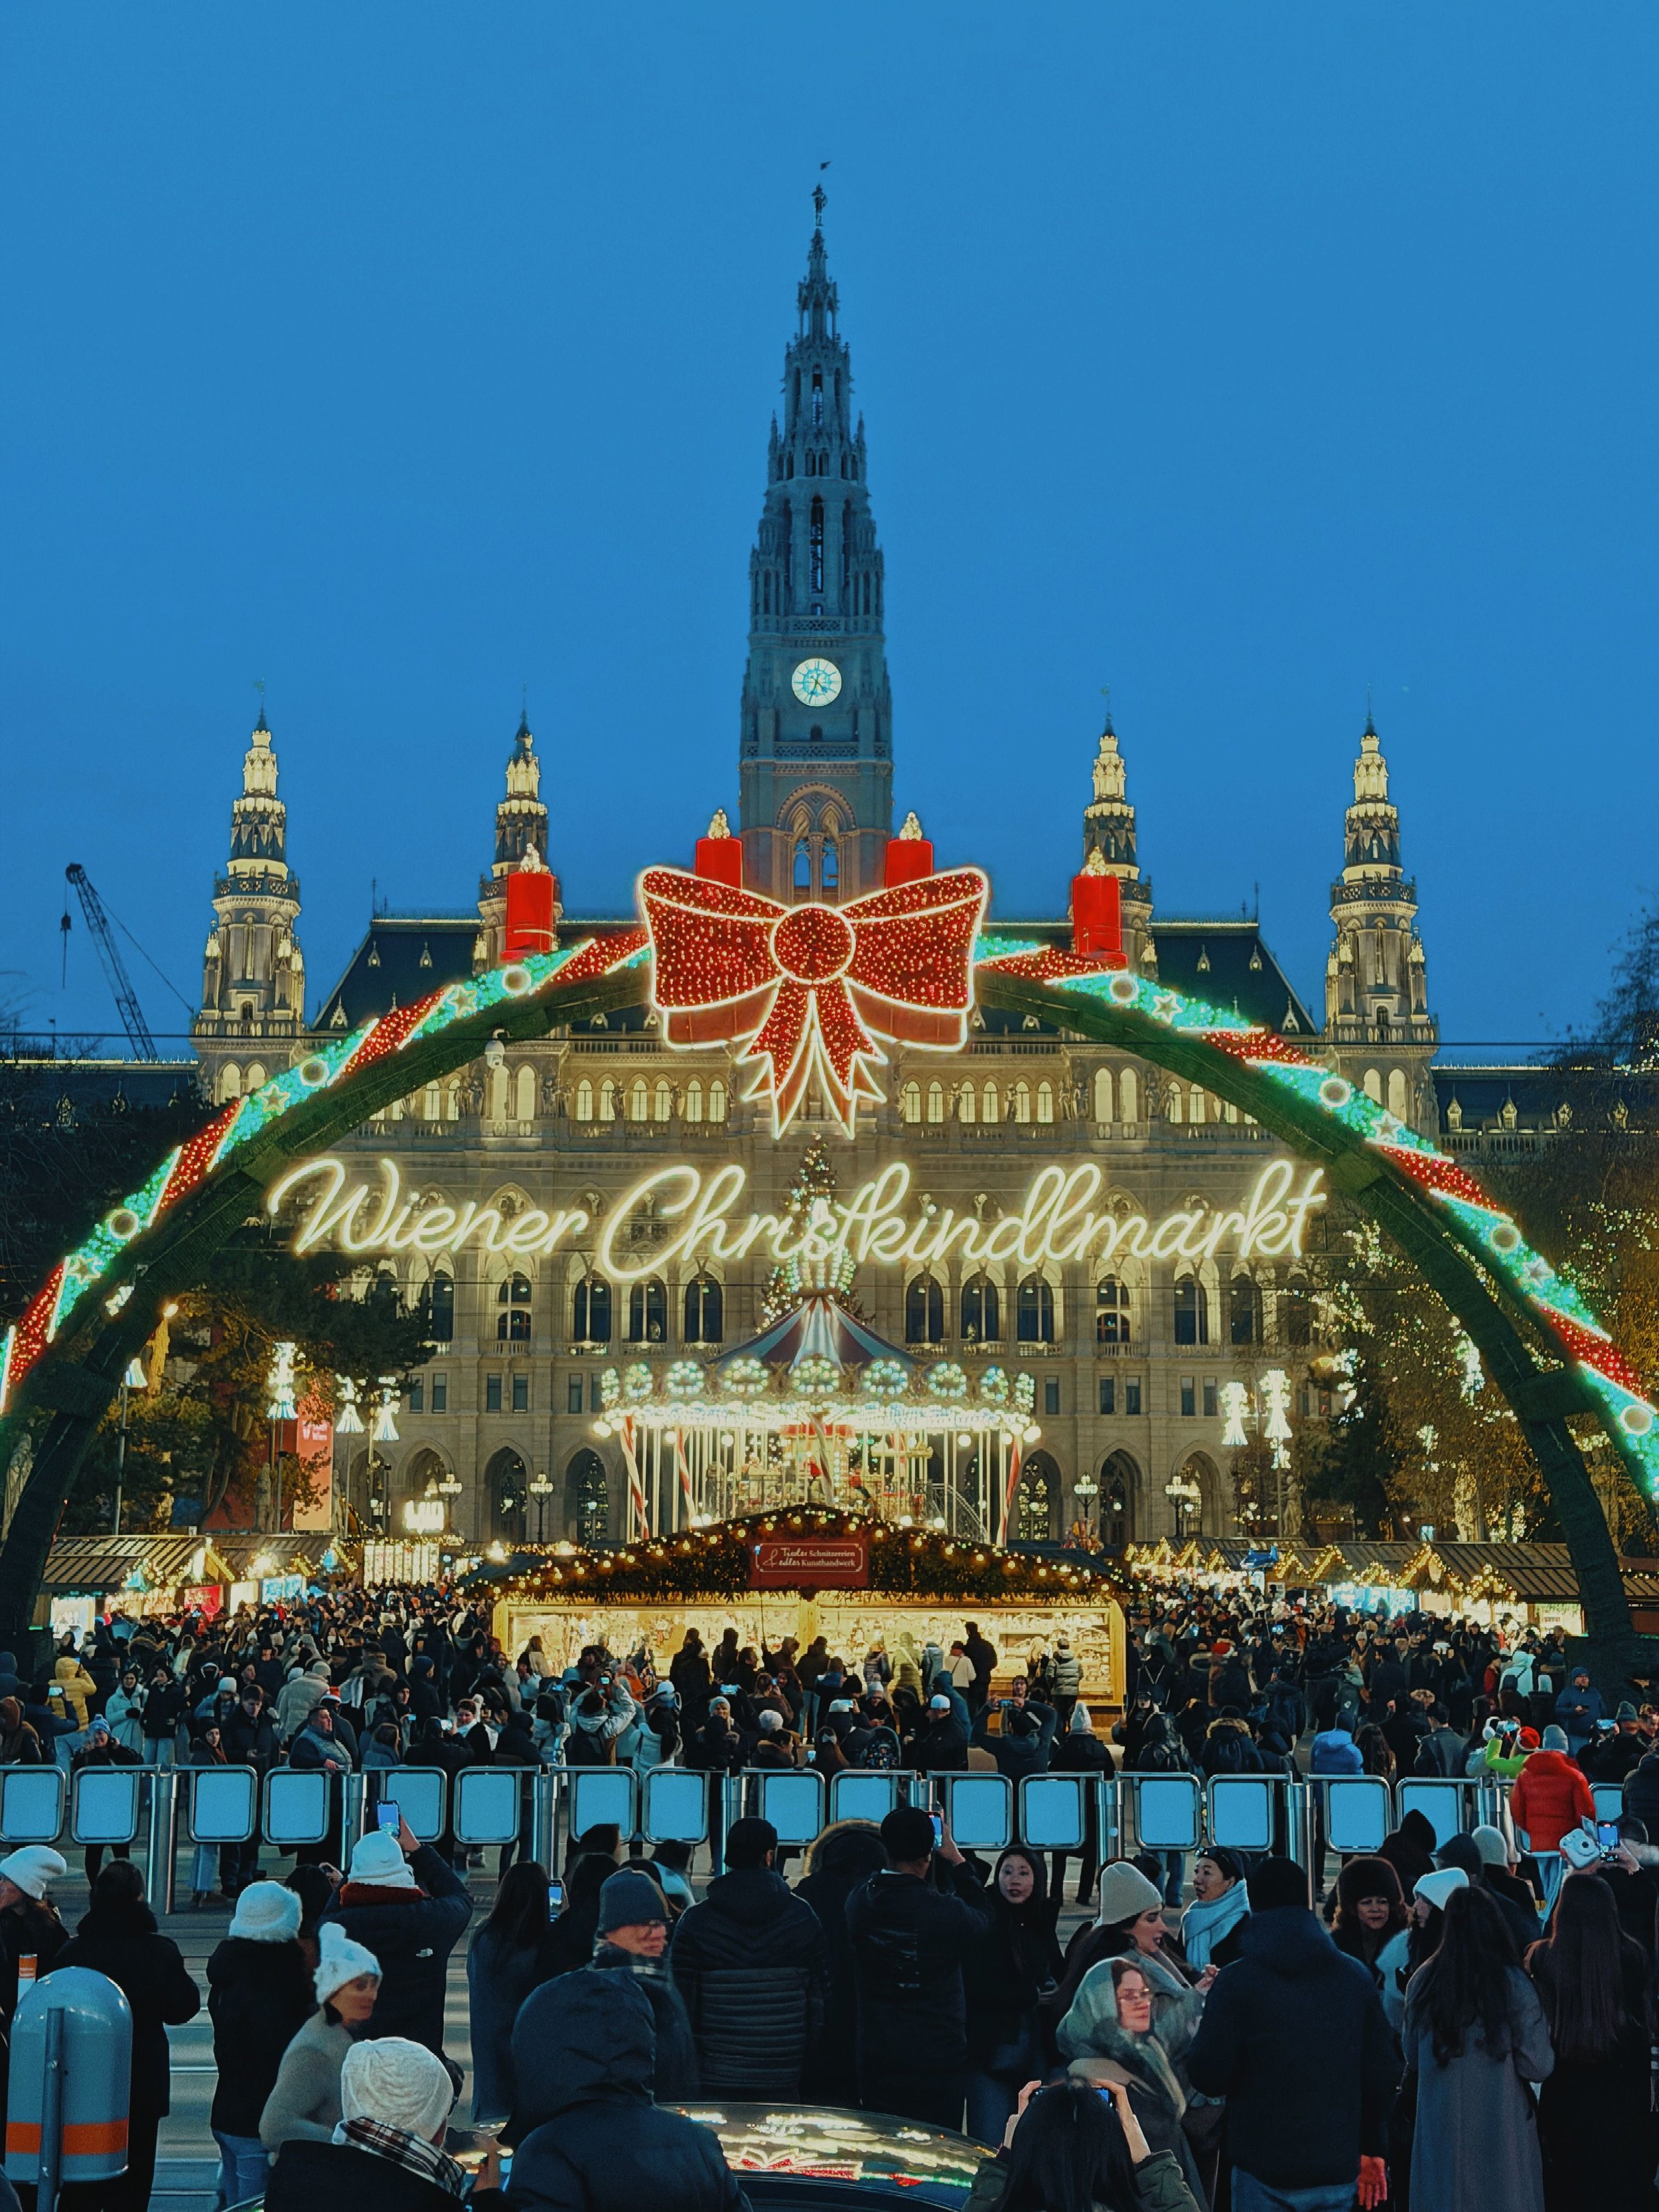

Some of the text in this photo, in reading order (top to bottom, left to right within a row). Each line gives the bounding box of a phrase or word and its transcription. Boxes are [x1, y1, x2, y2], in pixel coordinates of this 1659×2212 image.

[267, 1158, 1327, 1279] Wiener Christkindlmarkt
[801, 1558, 855, 1566] Kunsthandwerk
